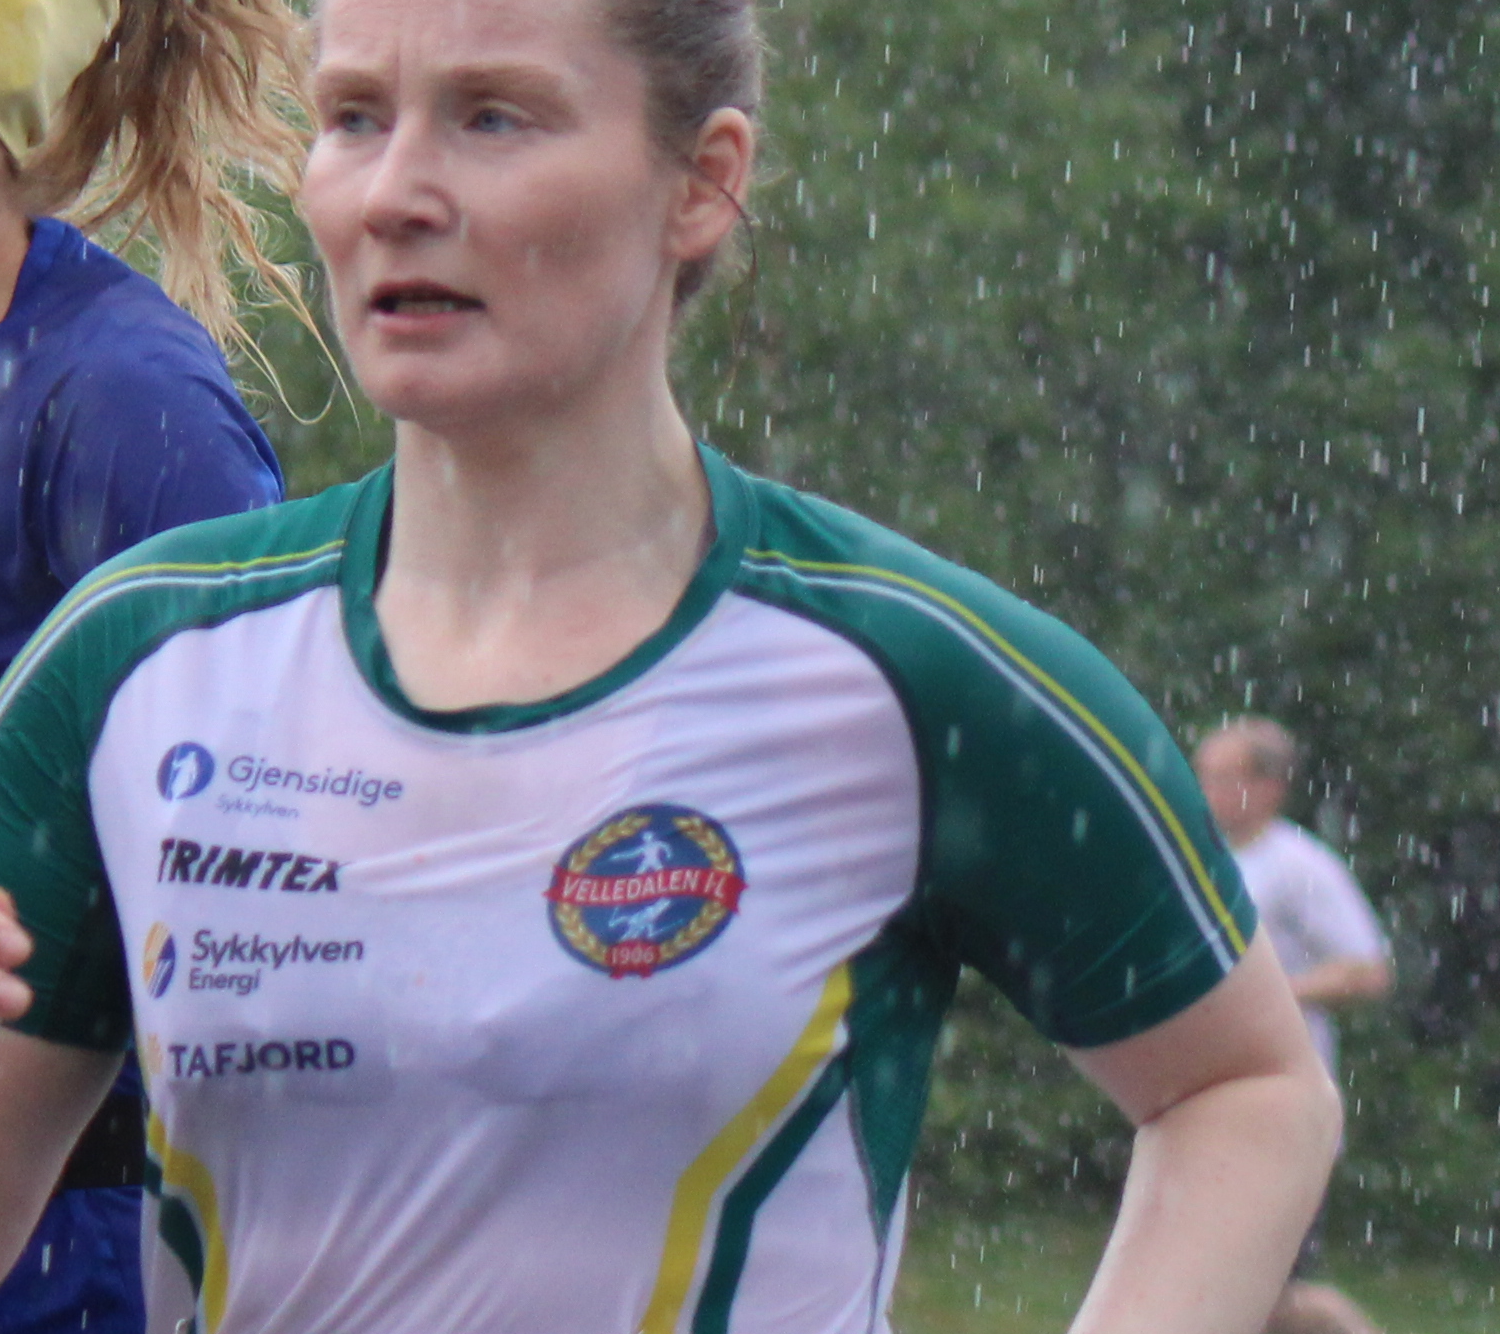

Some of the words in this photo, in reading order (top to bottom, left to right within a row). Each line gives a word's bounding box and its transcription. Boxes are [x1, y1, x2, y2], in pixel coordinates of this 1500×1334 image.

[228, 755, 404, 807] Gjensidige
[215, 794, 300, 819] Sykkylven
[158, 837, 342, 893] TRIMTEX
[562, 869, 700, 903] VELLEDALEN
[190, 929, 365, 970] Sykkylven
[611, 946, 655, 964] 1906
[189, 968, 261, 995] Energi
[168, 1038, 357, 1079] TAFJORD
